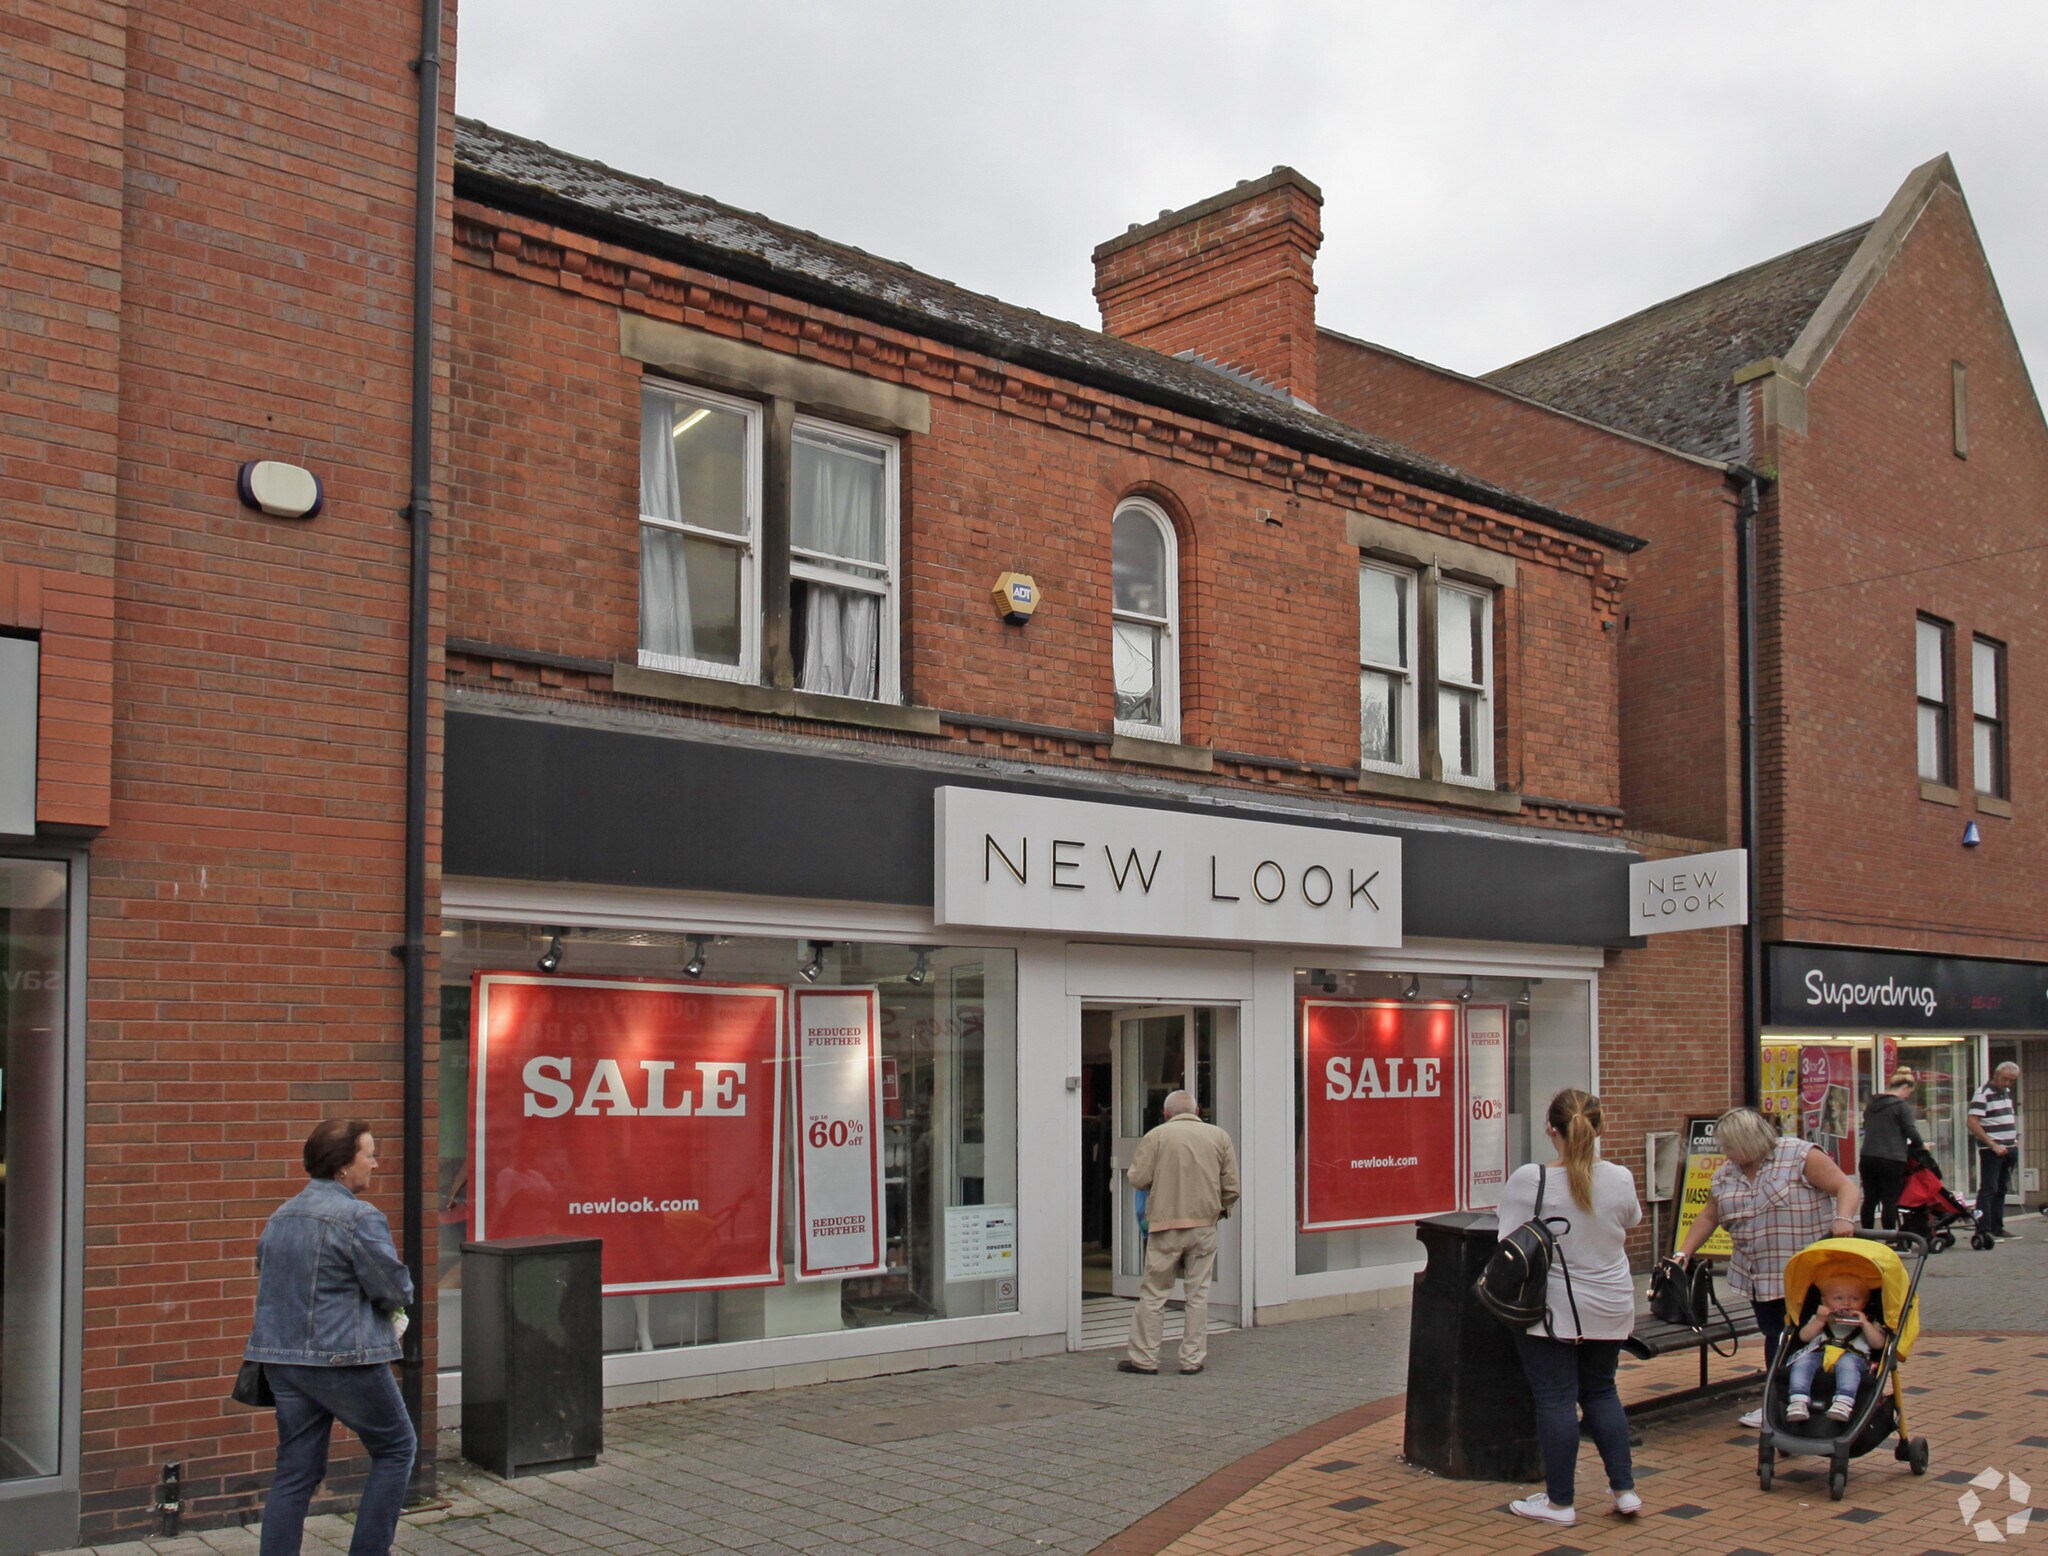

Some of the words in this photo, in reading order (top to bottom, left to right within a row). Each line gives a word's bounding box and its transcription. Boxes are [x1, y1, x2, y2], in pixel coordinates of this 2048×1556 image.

[1013, 586, 1032, 600] ADT
[983, 832, 1162, 894] NEW
[1211, 854, 1380, 911] LOOK
[1648, 870, 1718, 895] NEW
[1642, 891, 1726, 918] LOOK
[1805, 969, 1938, 1017] Superdrug
[808, 1027, 861, 1036] REDUCED
[808, 1036, 861, 1046] FURTHER
[1471, 1031, 1500, 1039] REDUCED
[522, 1055, 747, 1118] SALE
[1325, 1056, 1441, 1101] SALE
[1472, 1099, 1502, 1120] 60%
[808, 1120, 863, 1149] 60%
[848, 1137, 863, 1146] off
[1351, 1155, 1418, 1169] newlook.com
[568, 1196, 700, 1216] newlook.com
[812, 1215, 866, 1228] REDUCED
[812, 1224, 866, 1238] FURTHER
